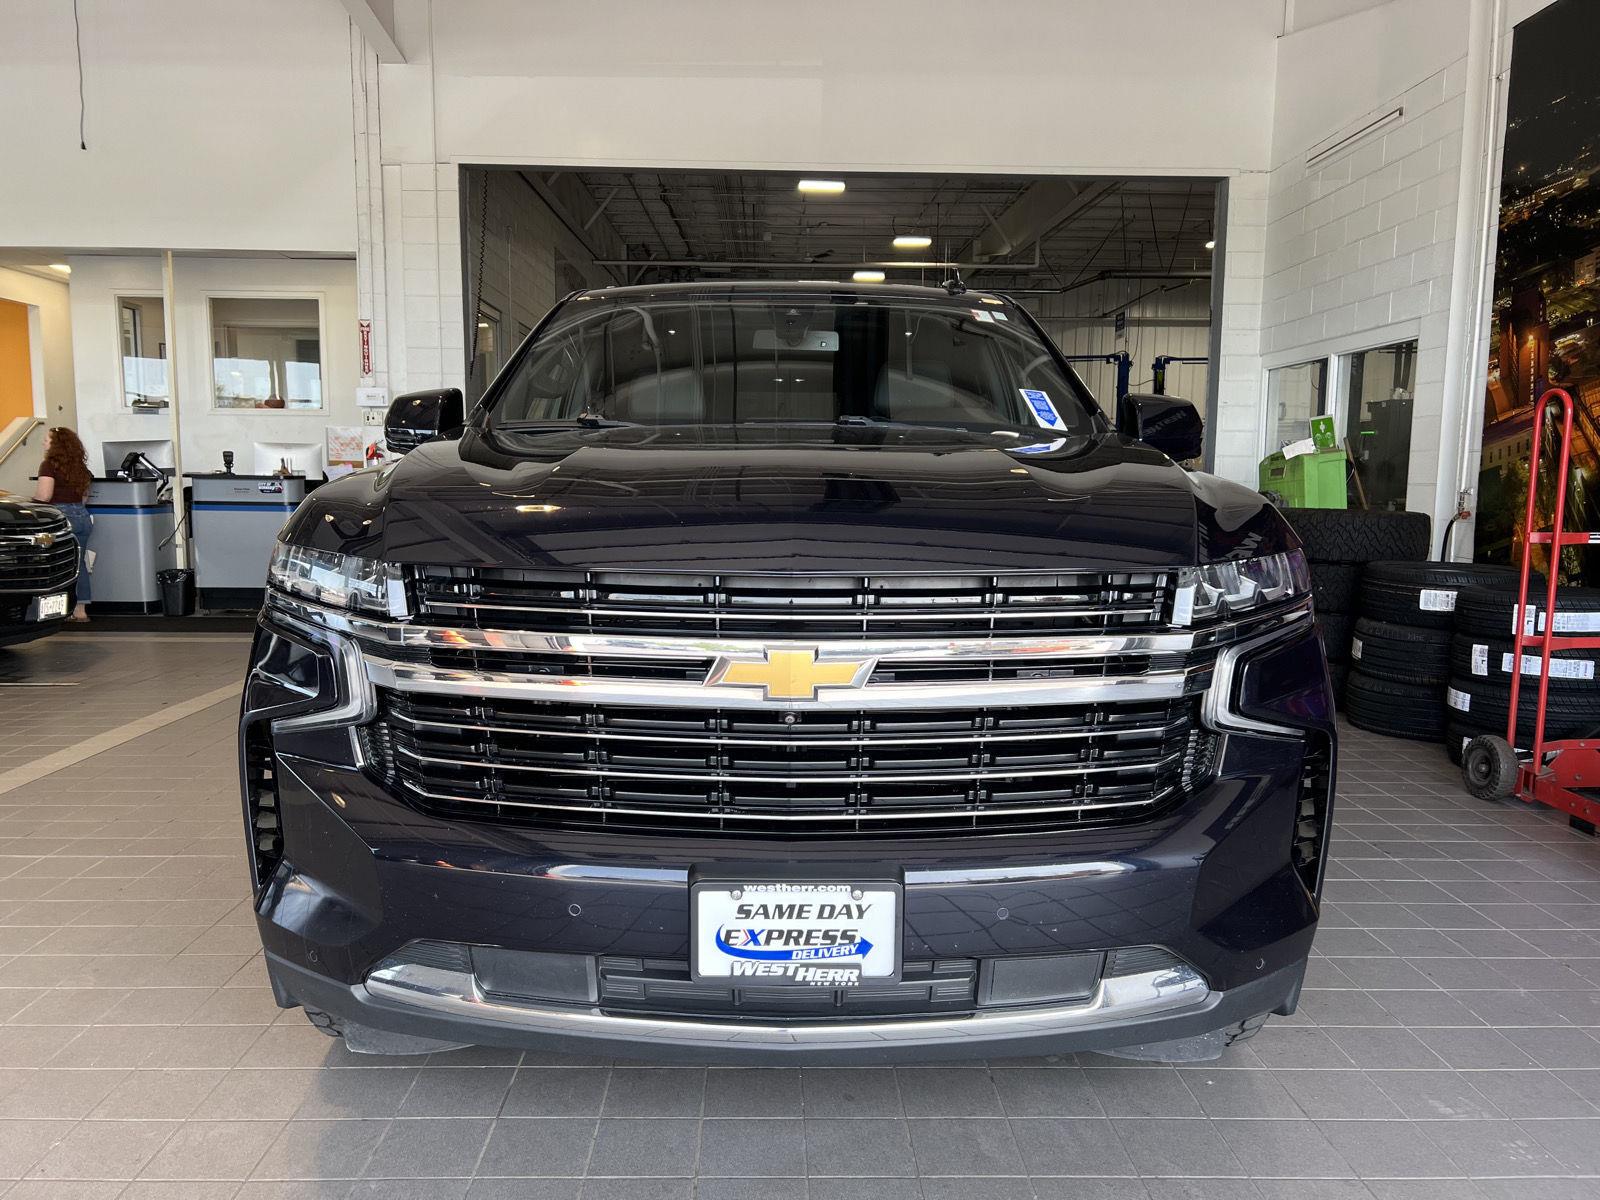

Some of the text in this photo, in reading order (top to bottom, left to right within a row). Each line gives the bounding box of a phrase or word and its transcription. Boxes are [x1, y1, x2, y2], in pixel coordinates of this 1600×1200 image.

[743, 883, 851, 893] westherr.com
[735, 904, 873, 920] SAME DAY
[724, 928, 858, 946] EXPRESS
[791, 943, 858, 960] DELIVERY
